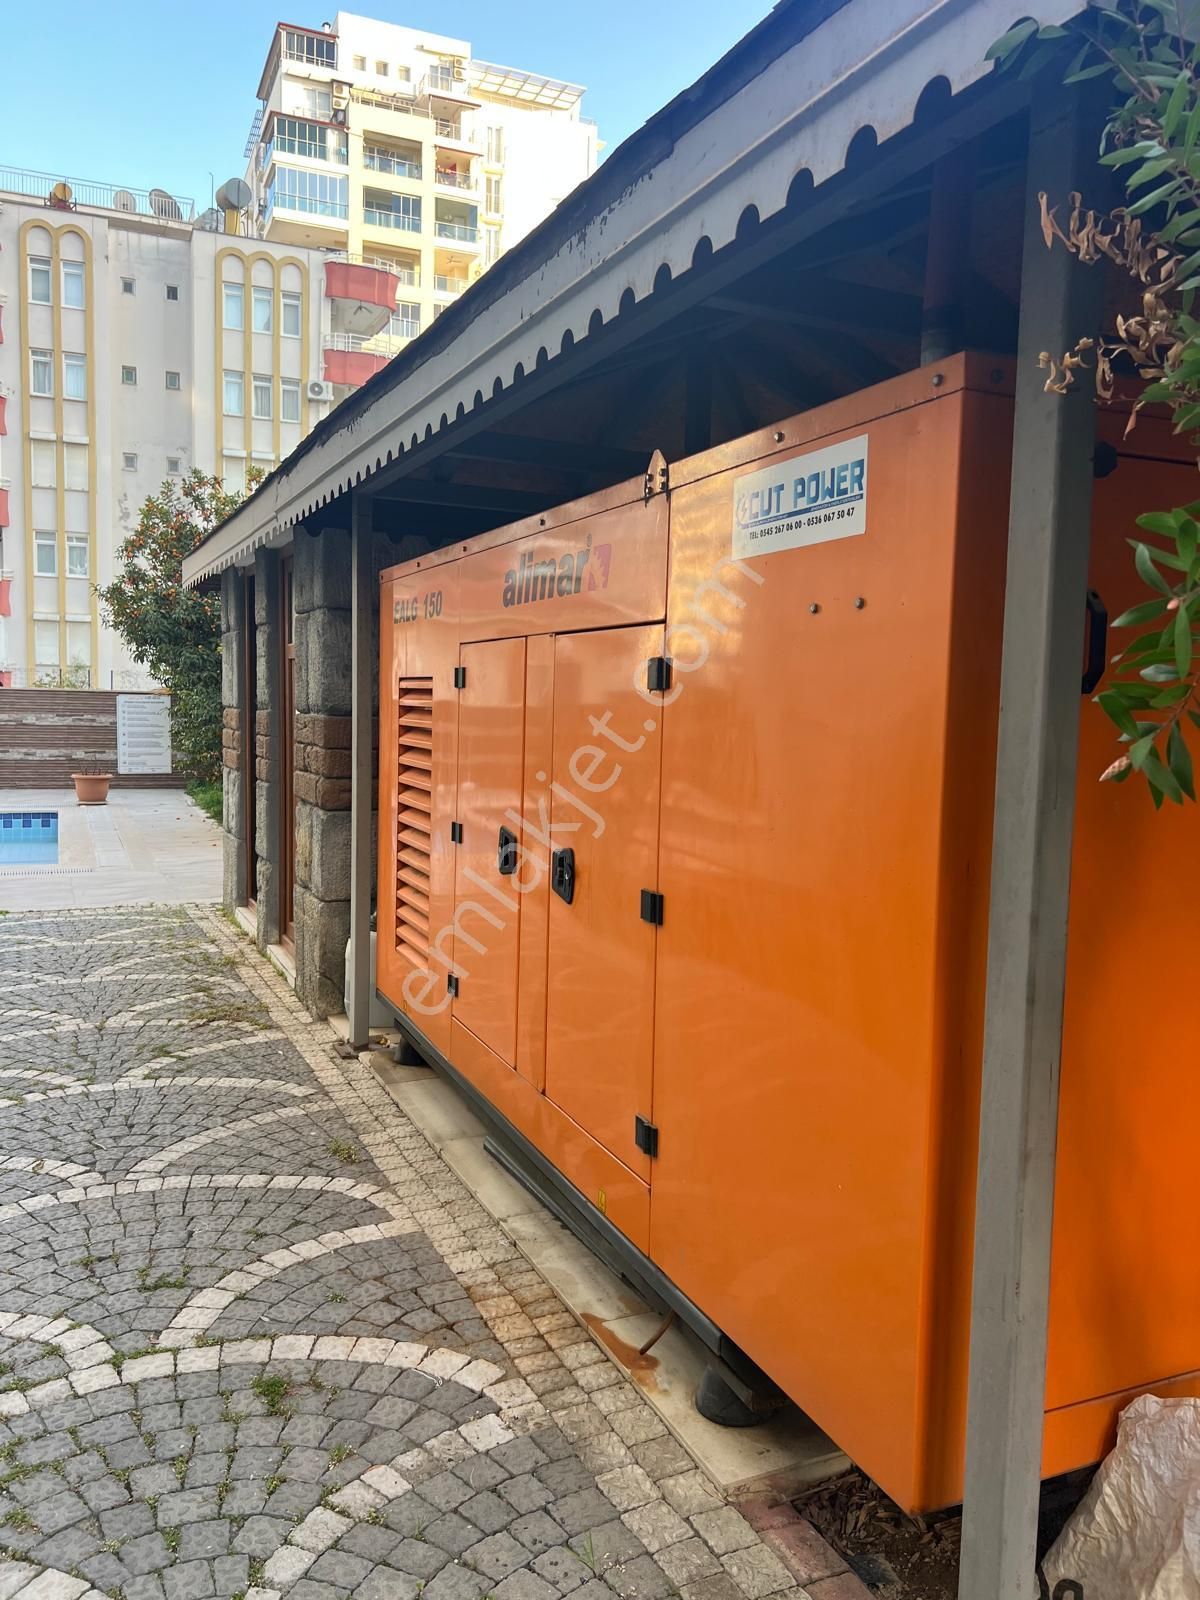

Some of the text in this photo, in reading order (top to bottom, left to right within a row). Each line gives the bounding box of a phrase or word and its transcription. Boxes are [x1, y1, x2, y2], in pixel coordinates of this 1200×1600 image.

[793, 458, 865, 509] POWER
[760, 527, 773, 538] 0545
[774, 524, 786, 535] 267
[786, 521, 794, 532] 06
[794, 519, 802, 530] 00
[806, 514, 822, 527] 0536
[823, 511, 836, 523] 067
[836, 509, 846, 520] 50
[846, 506, 855, 517] 47
[502, 548, 591, 608] alimar
[423, 590, 443, 620] 150
